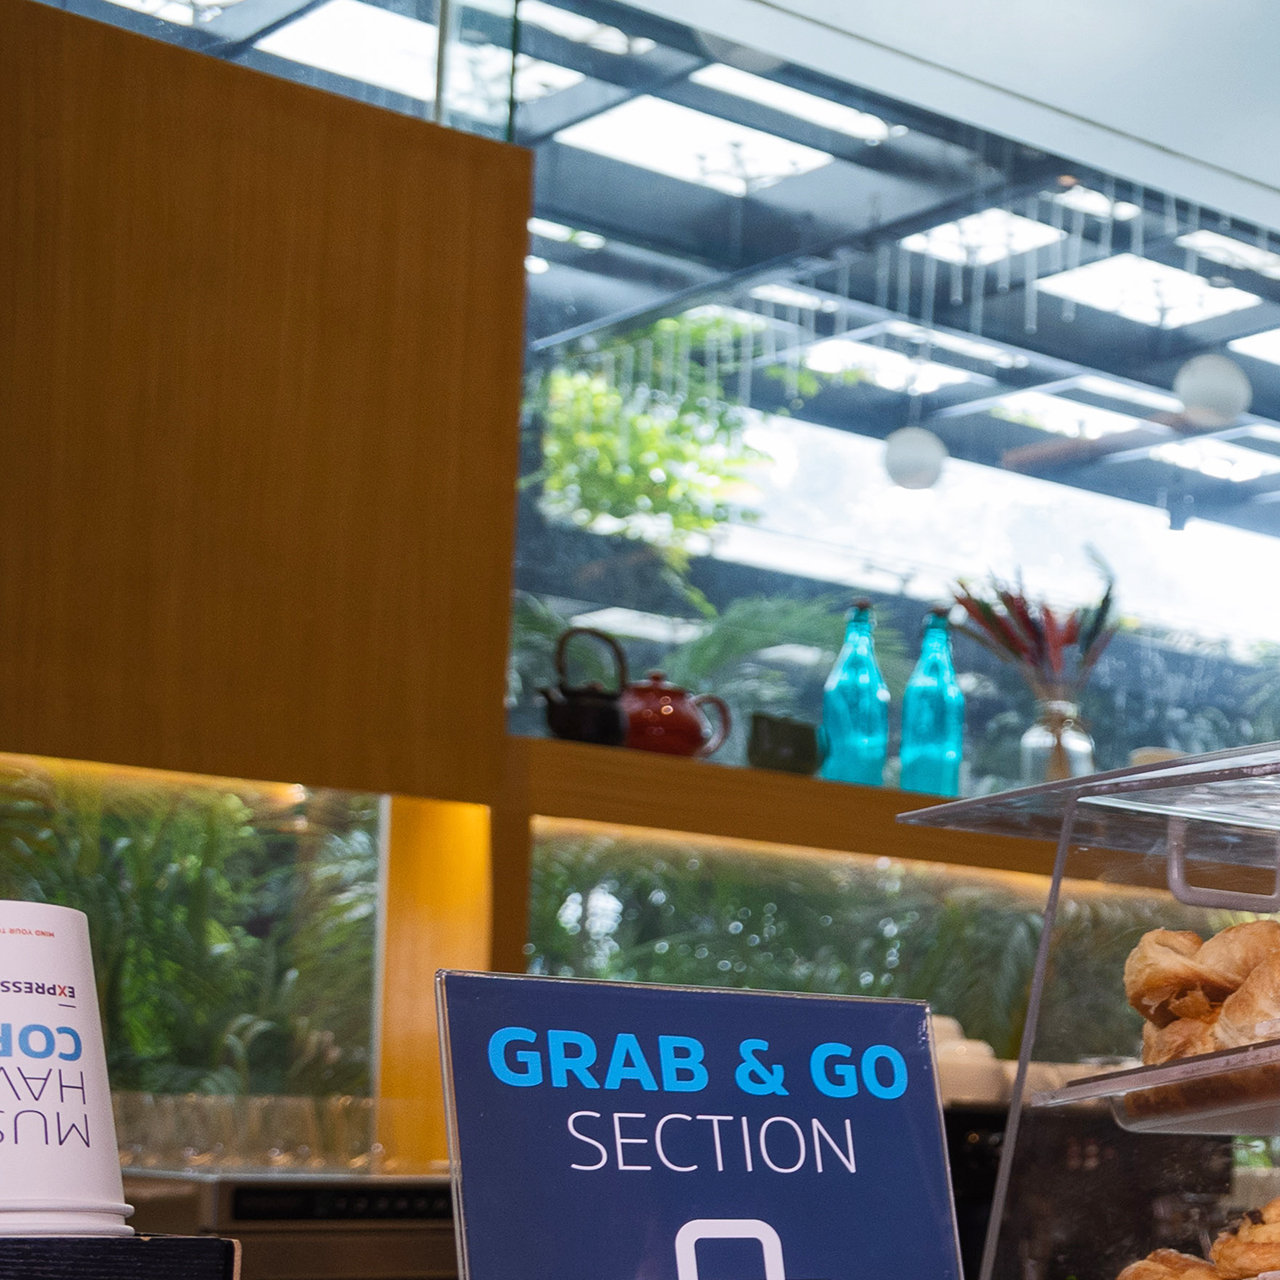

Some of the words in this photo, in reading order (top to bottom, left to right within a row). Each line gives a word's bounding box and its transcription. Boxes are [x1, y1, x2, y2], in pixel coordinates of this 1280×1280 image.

[0, 981, 76, 999] EXPRESS
[488, 1026, 710, 1092] GRAB
[735, 1038, 789, 1096] &
[810, 1042, 908, 1099] GO
[0, 1109, 90, 1148] MU
[567, 1110, 857, 1173] SECTION
